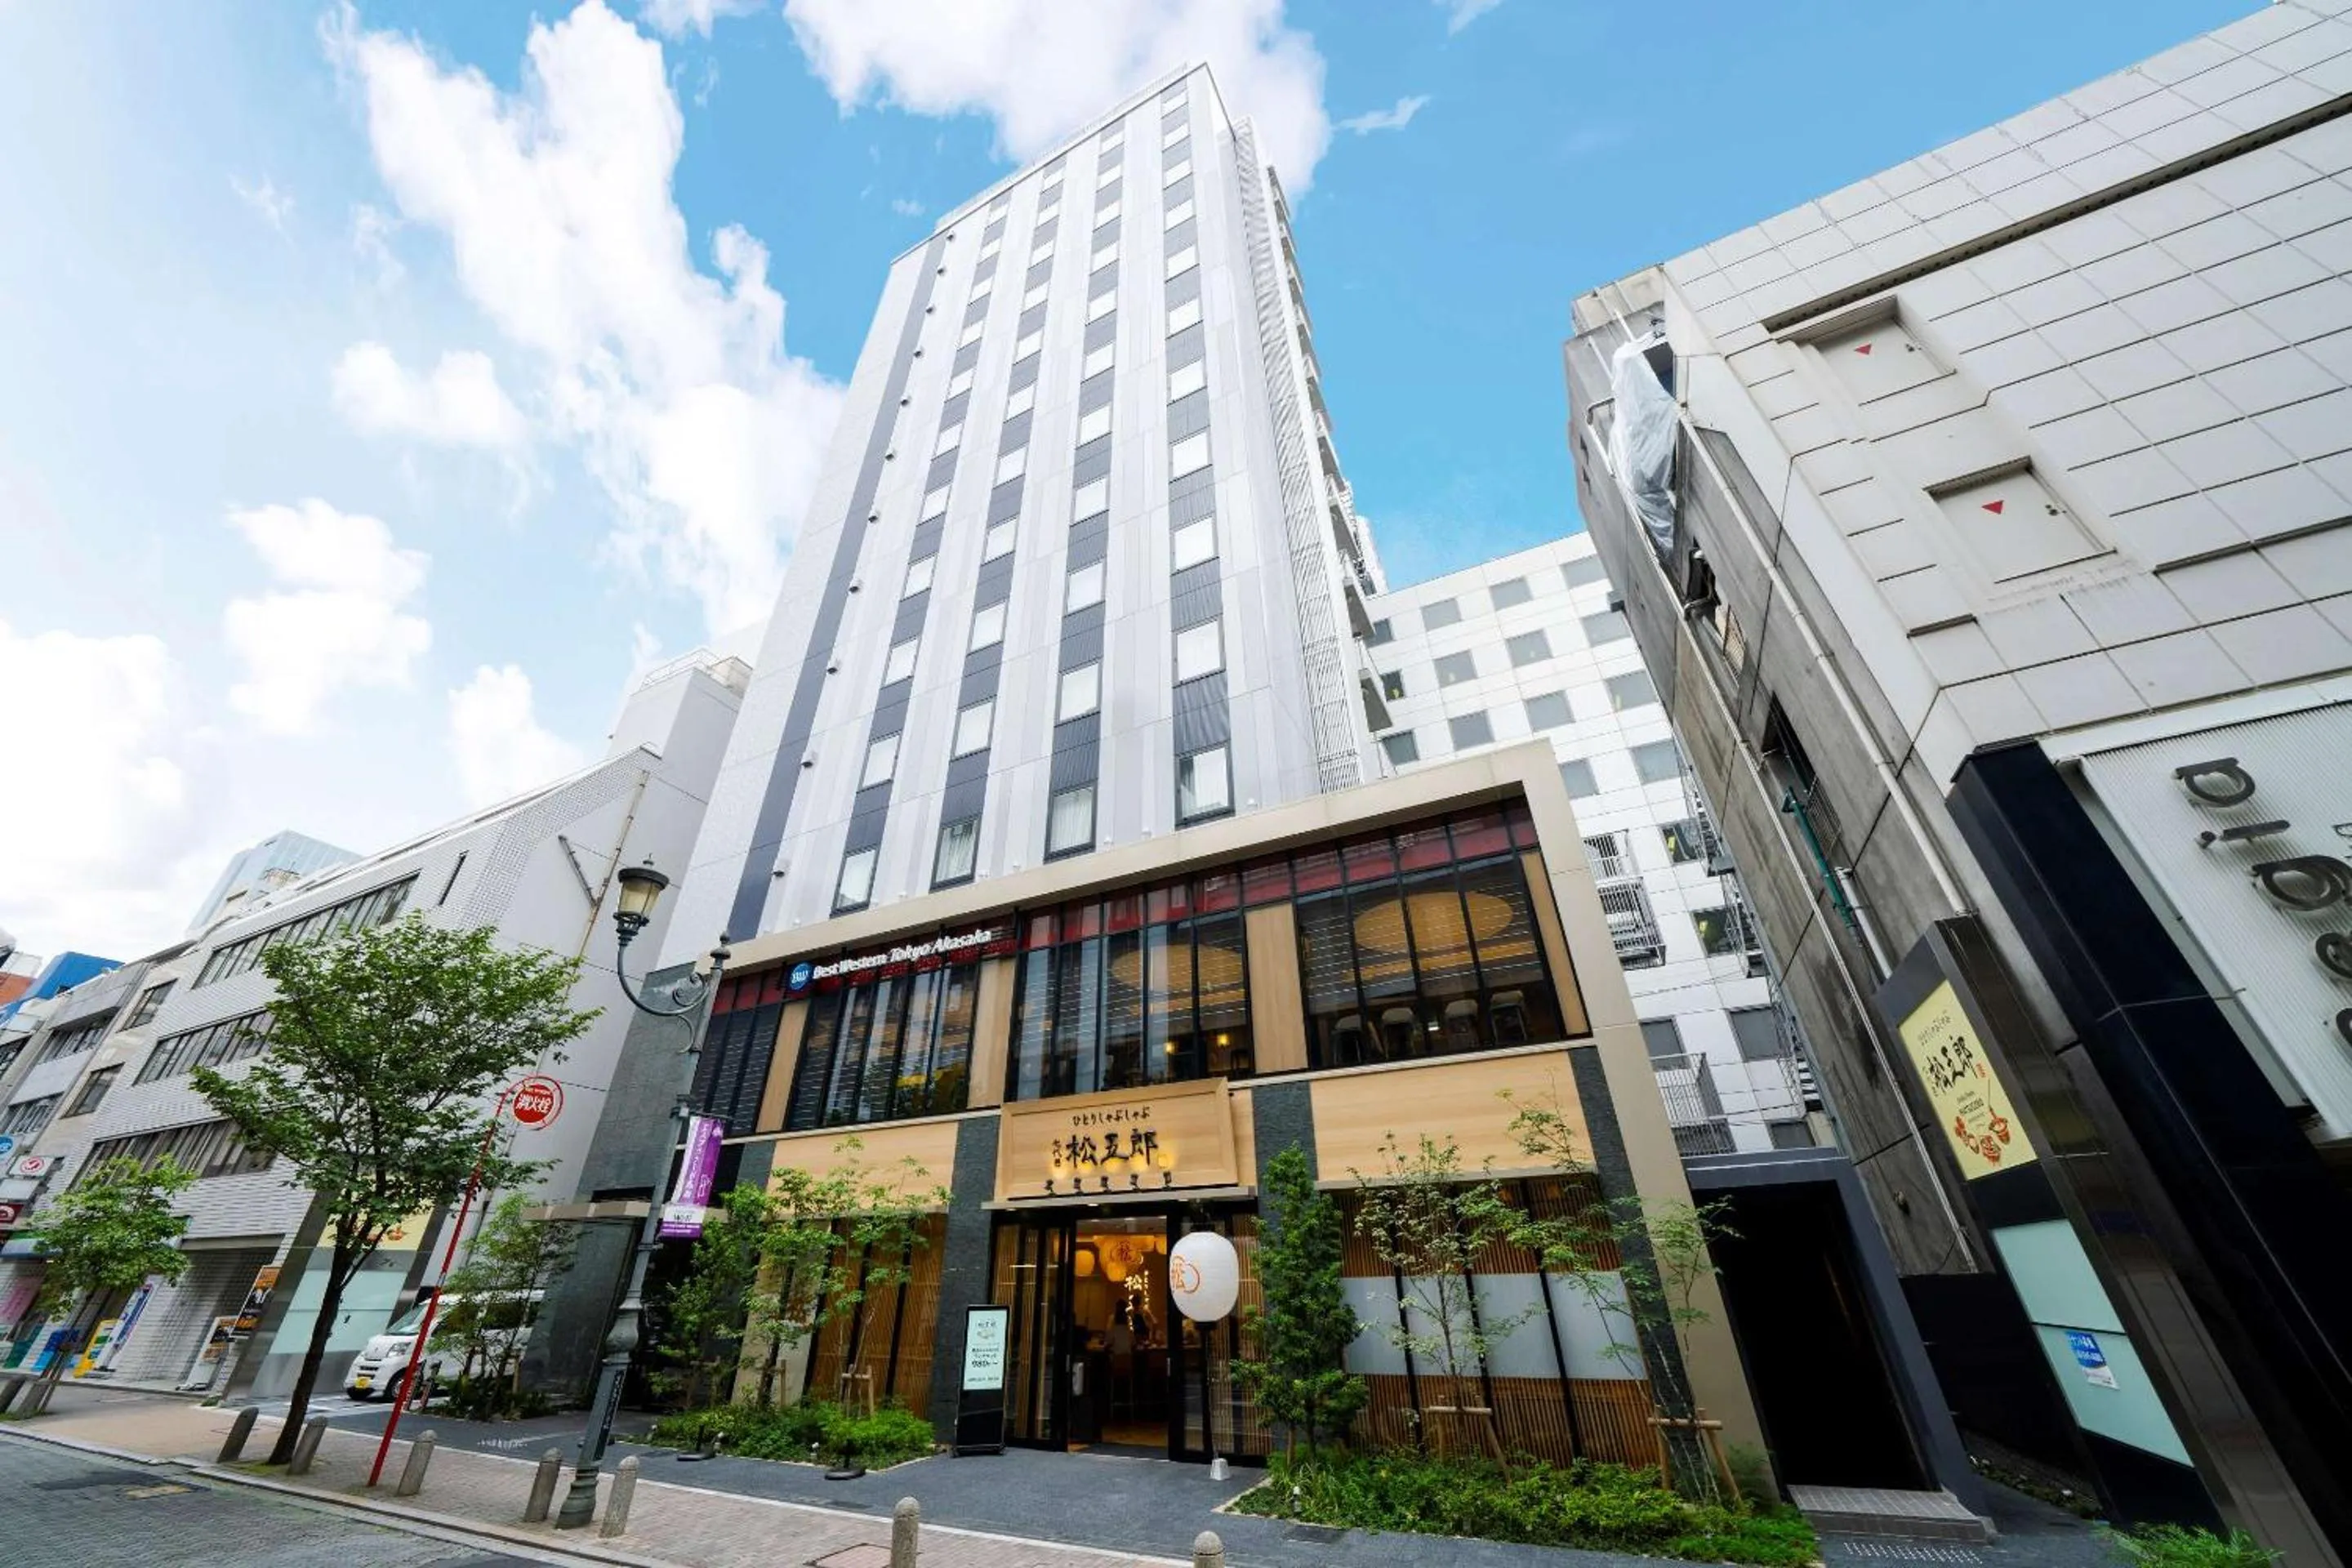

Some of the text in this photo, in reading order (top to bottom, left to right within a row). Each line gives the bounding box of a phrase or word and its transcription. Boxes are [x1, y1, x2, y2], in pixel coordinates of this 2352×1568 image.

[813, 929, 991, 979] Best Western Tokyo Akasaka
[1072, 1107, 1150, 1126] ひとりしゃぶしゃぶ
[1066, 1128, 1158, 1169] 松五郎
